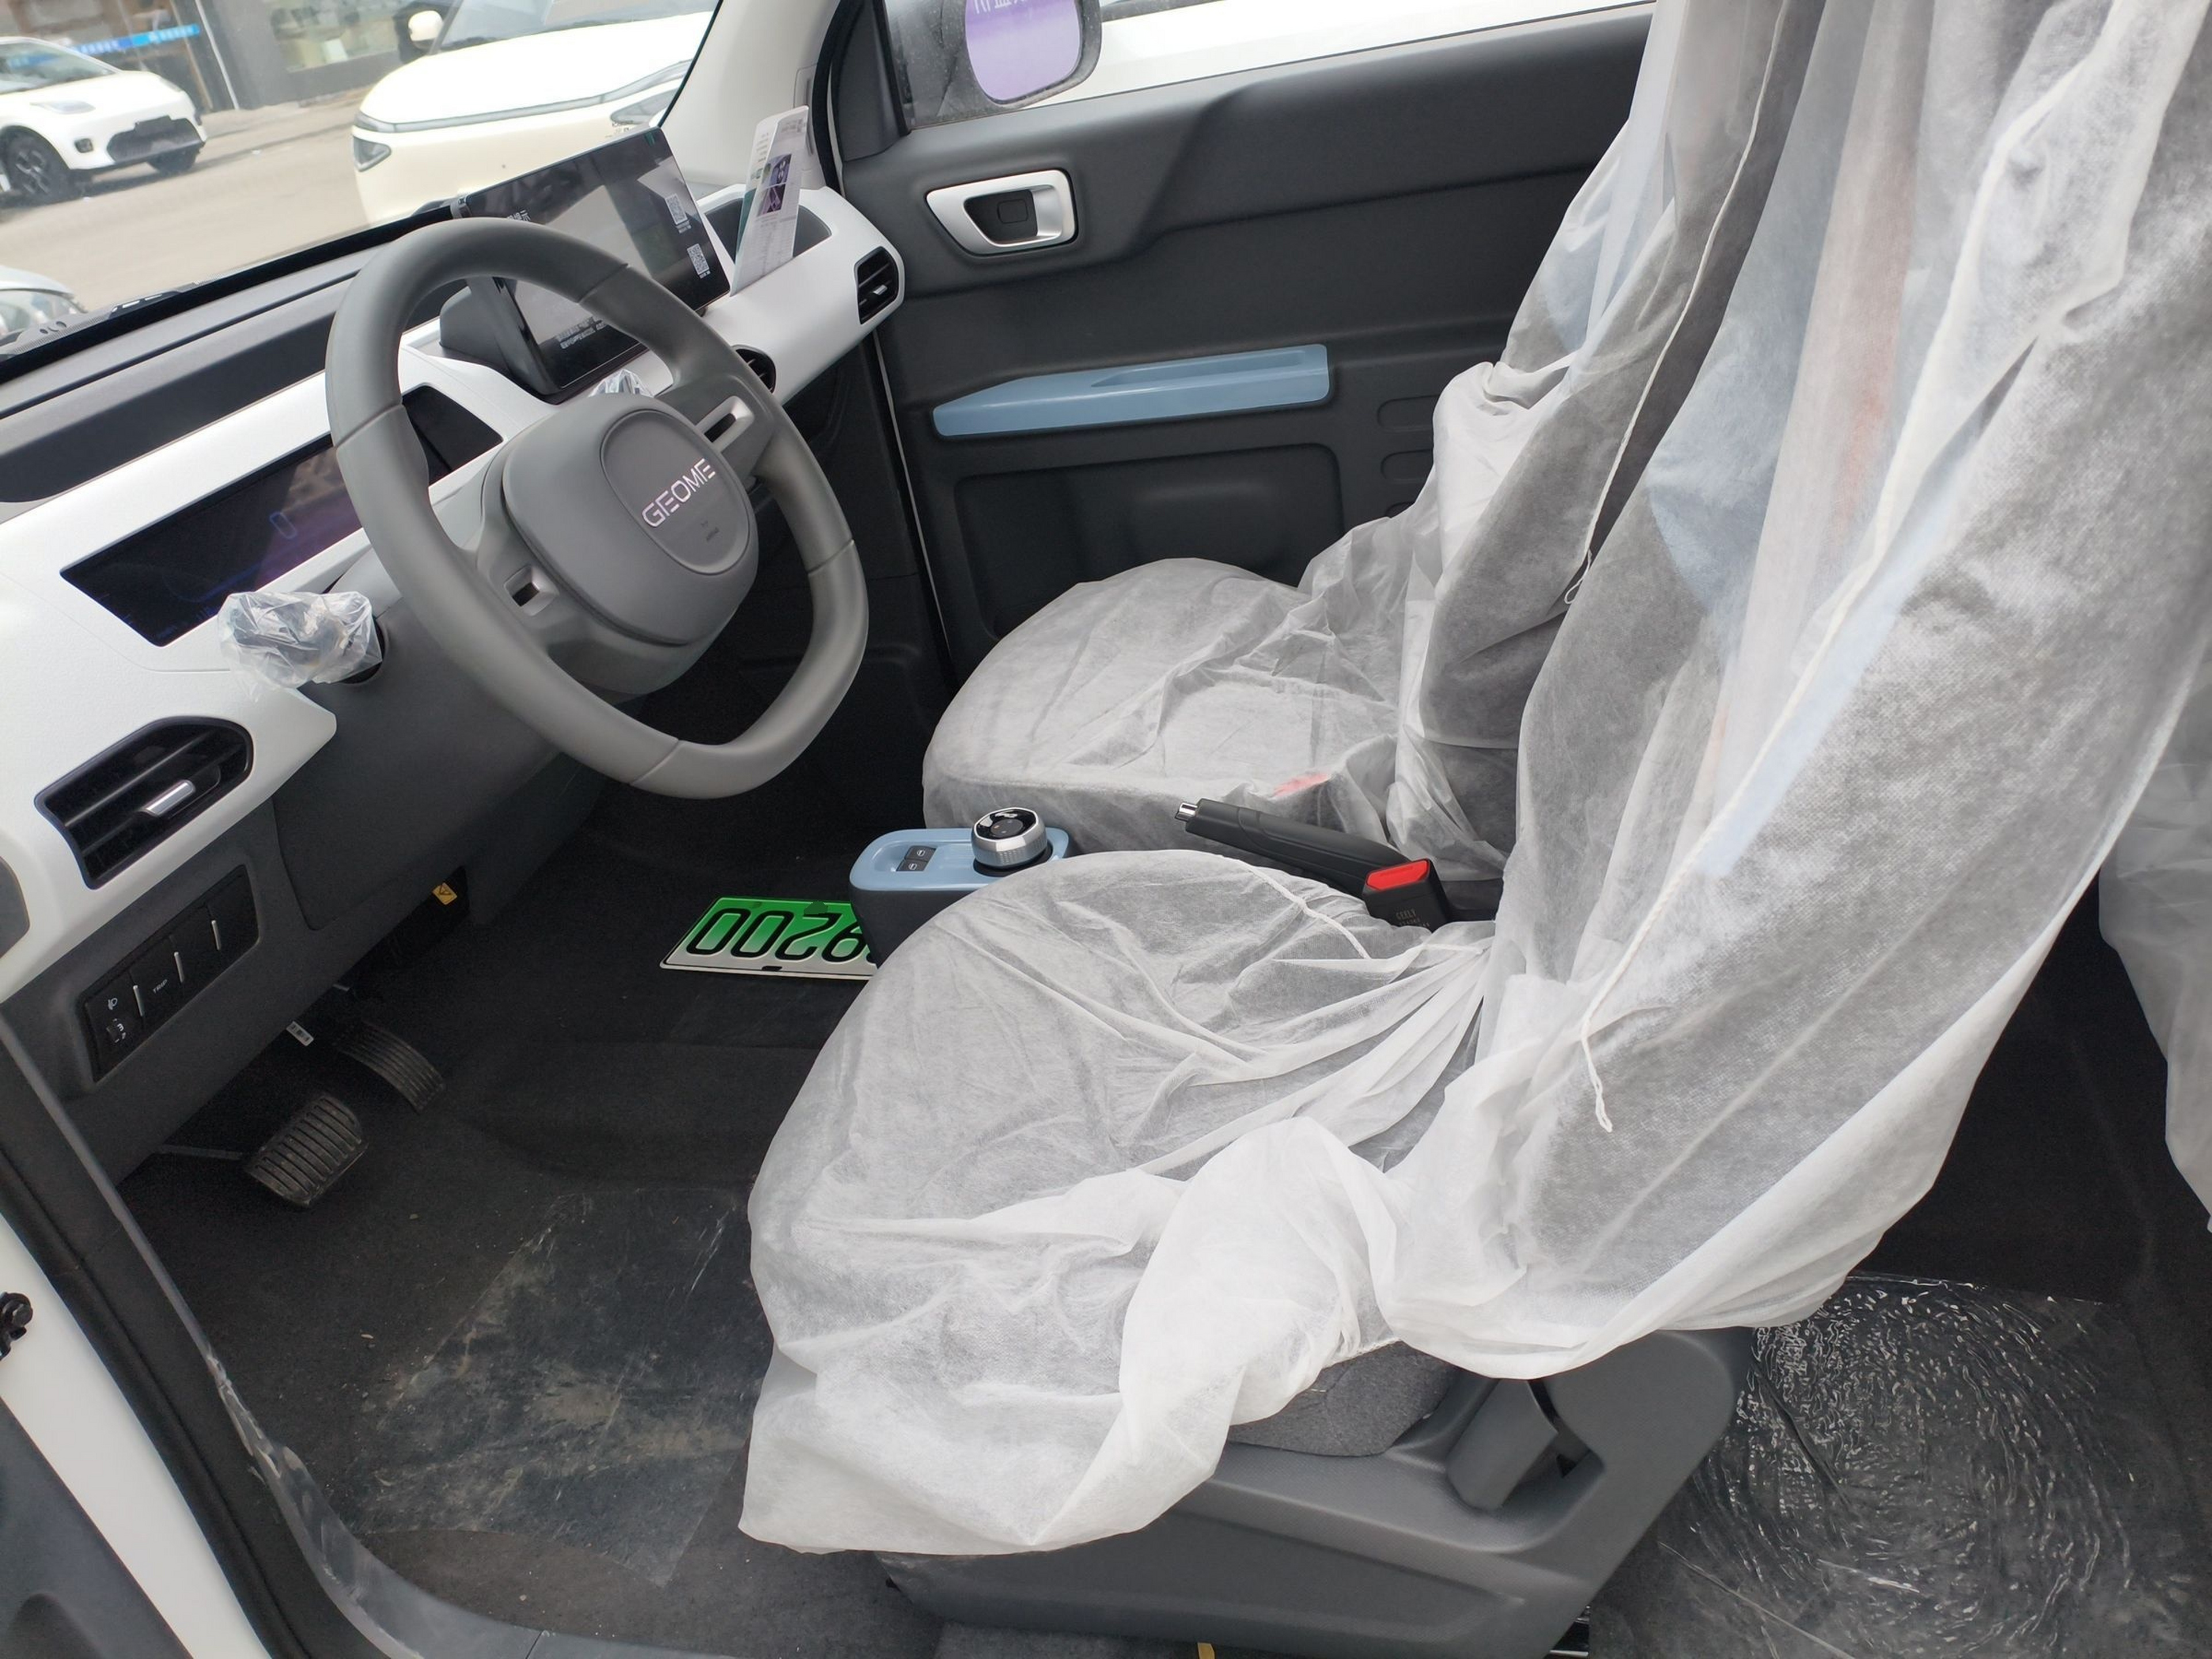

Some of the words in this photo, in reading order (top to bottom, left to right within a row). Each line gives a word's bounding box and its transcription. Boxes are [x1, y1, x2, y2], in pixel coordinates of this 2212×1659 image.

[642, 458, 716, 528] GEOME
[686, 908, 876, 964] 9200
[153, 979, 168, 994] TRIP
